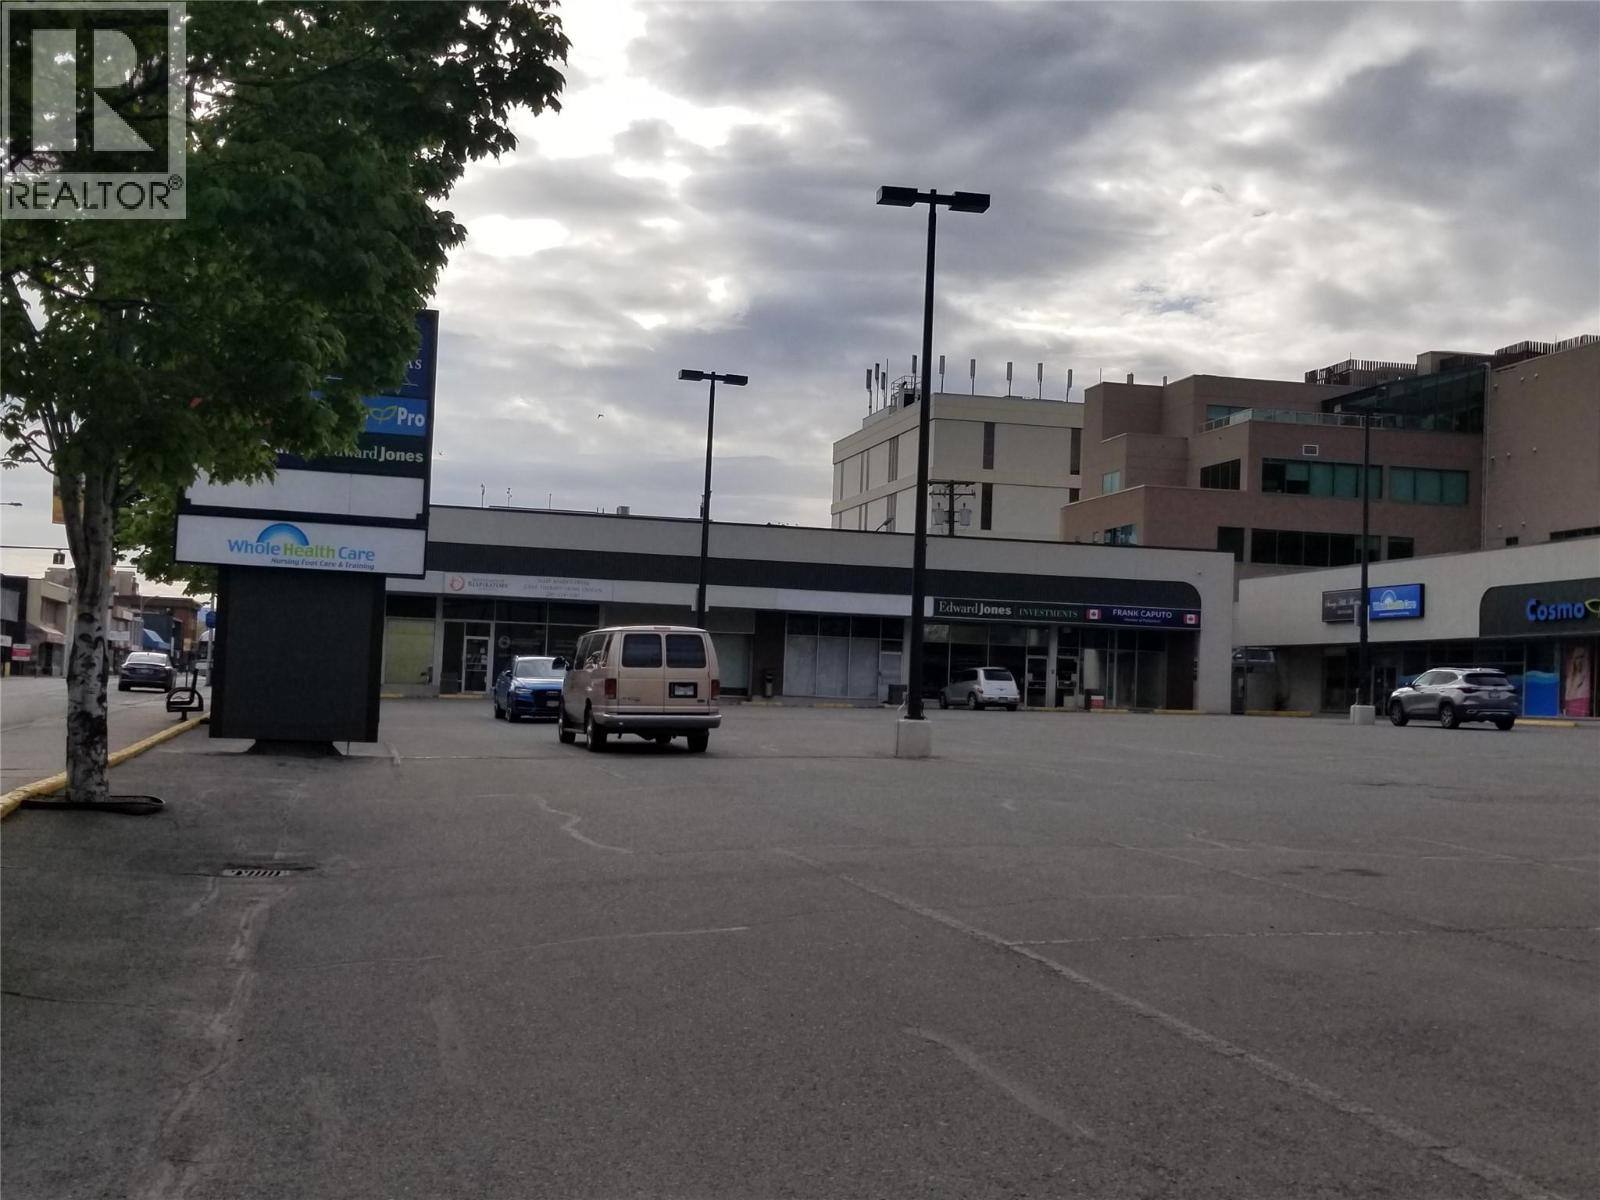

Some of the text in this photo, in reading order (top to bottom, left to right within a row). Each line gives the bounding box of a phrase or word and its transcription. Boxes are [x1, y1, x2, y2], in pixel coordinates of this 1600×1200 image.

[397, 406, 425, 427] Pro
[228, 539, 375, 562] Whole Health Care
[271, 558, 299, 567] Nursing
[320, 560, 336, 568] Care
[345, 561, 375, 570] Training
[1019, 607, 1079, 618] INVESTMENTS
[1112, 608, 1173, 619] FRANK CAPUTO
[1526, 598, 1585, 621] Cosmo
